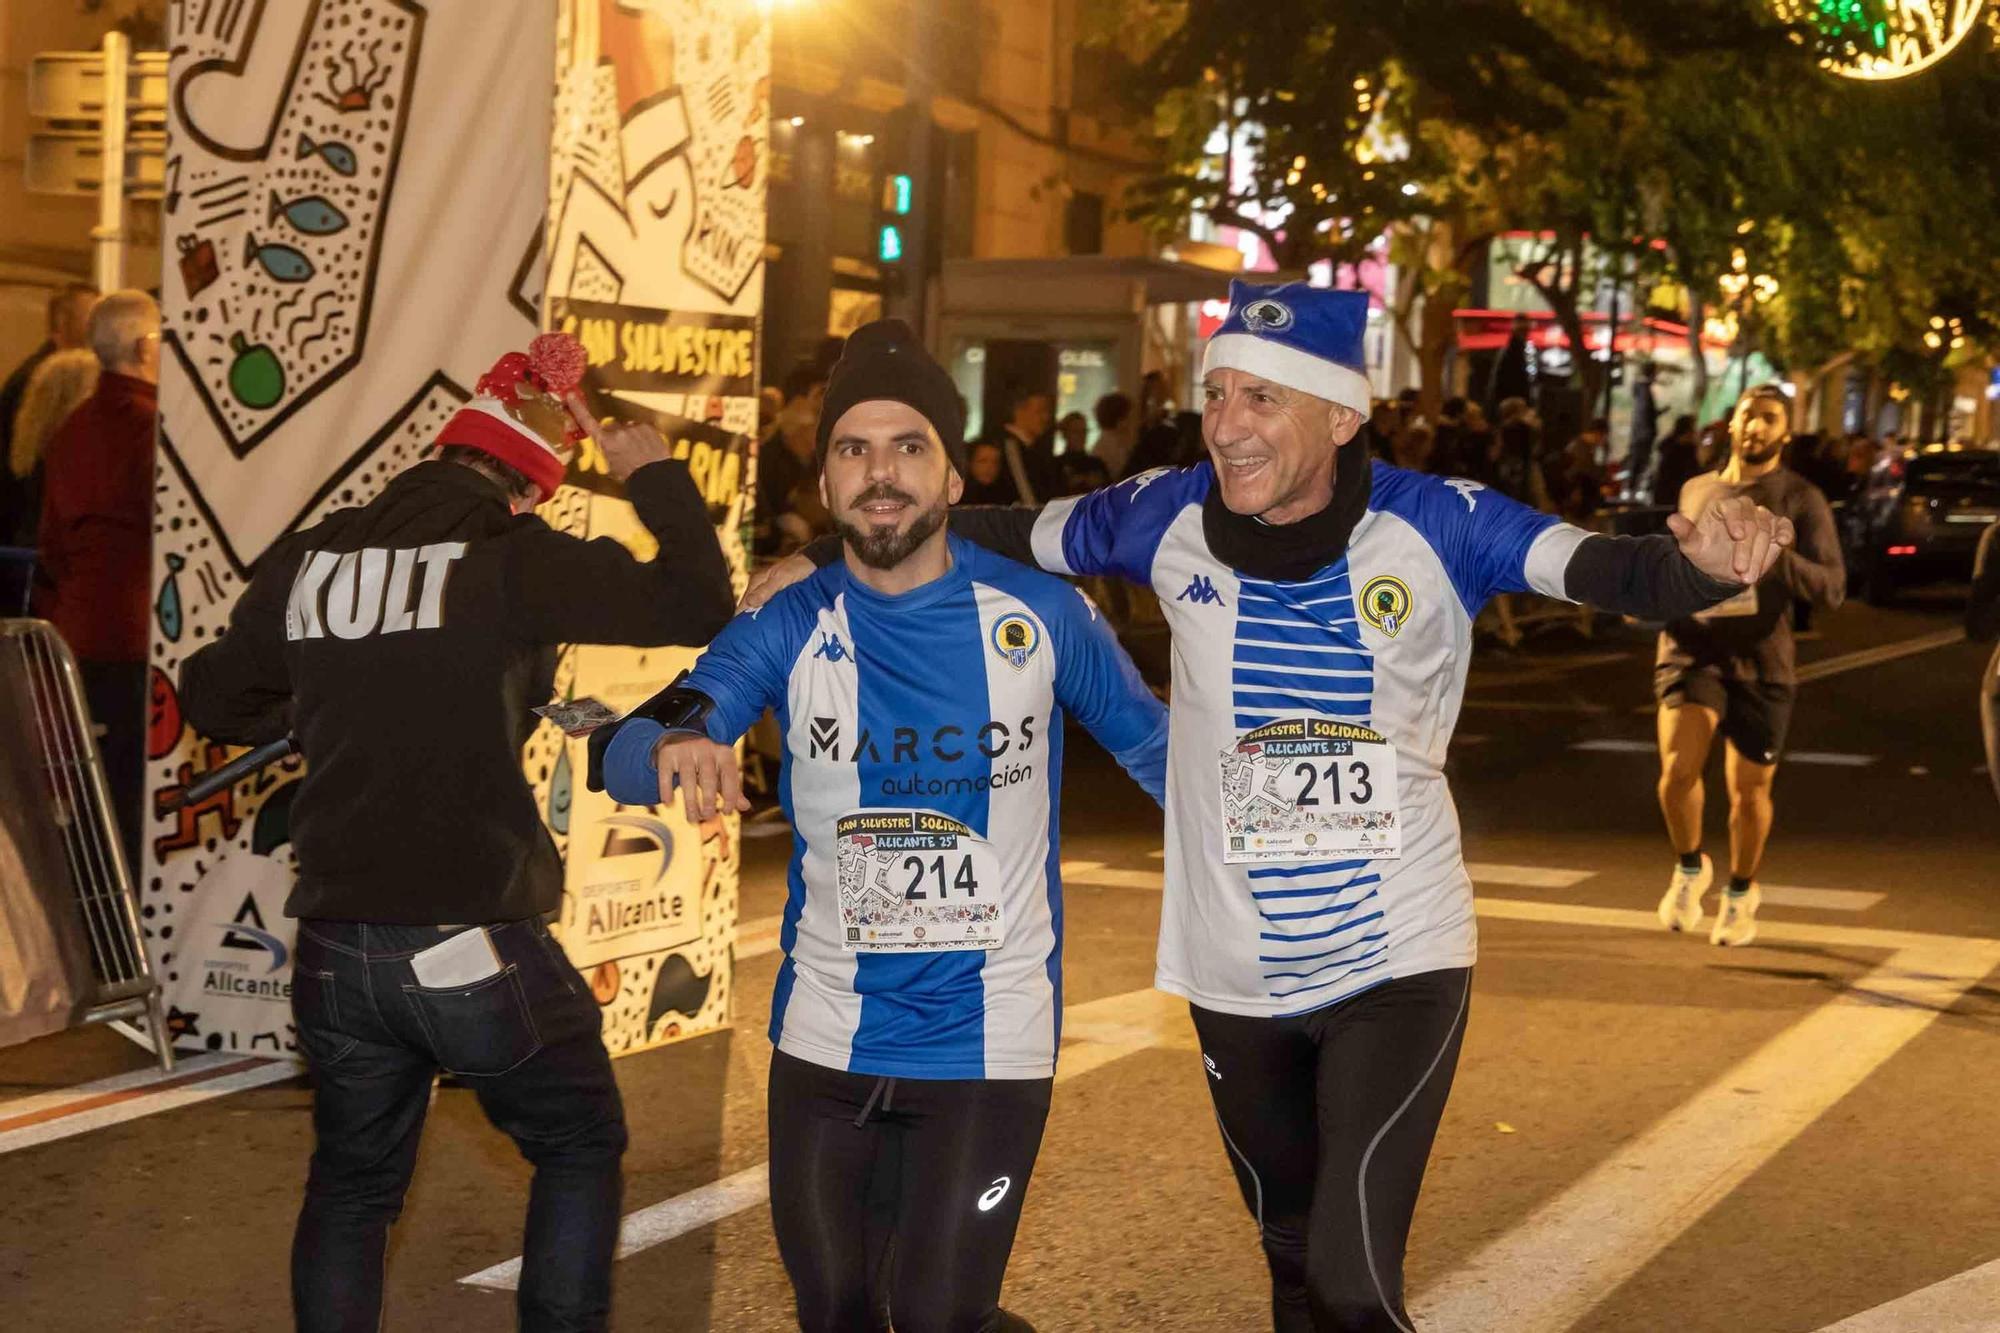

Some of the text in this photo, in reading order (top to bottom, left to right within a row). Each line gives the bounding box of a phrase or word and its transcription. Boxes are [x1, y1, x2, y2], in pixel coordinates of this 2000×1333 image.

[621, 320, 753, 377] SILVESTRE
[286, 542, 468, 642] KULT
[810, 716, 1035, 762] MARCOS
[1249, 723, 1304, 740] SILVESTRE
[1266, 742, 1330, 755] ALICANTE
[1295, 761, 1373, 806] 213
[838, 819, 858, 833] SAN
[860, 817, 912, 829] SILVESTRE
[878, 836, 936, 848] ALICANTE
[903, 854, 979, 900] 214
[586, 893, 683, 935] Alicante
[204, 970, 294, 998] Alicante
